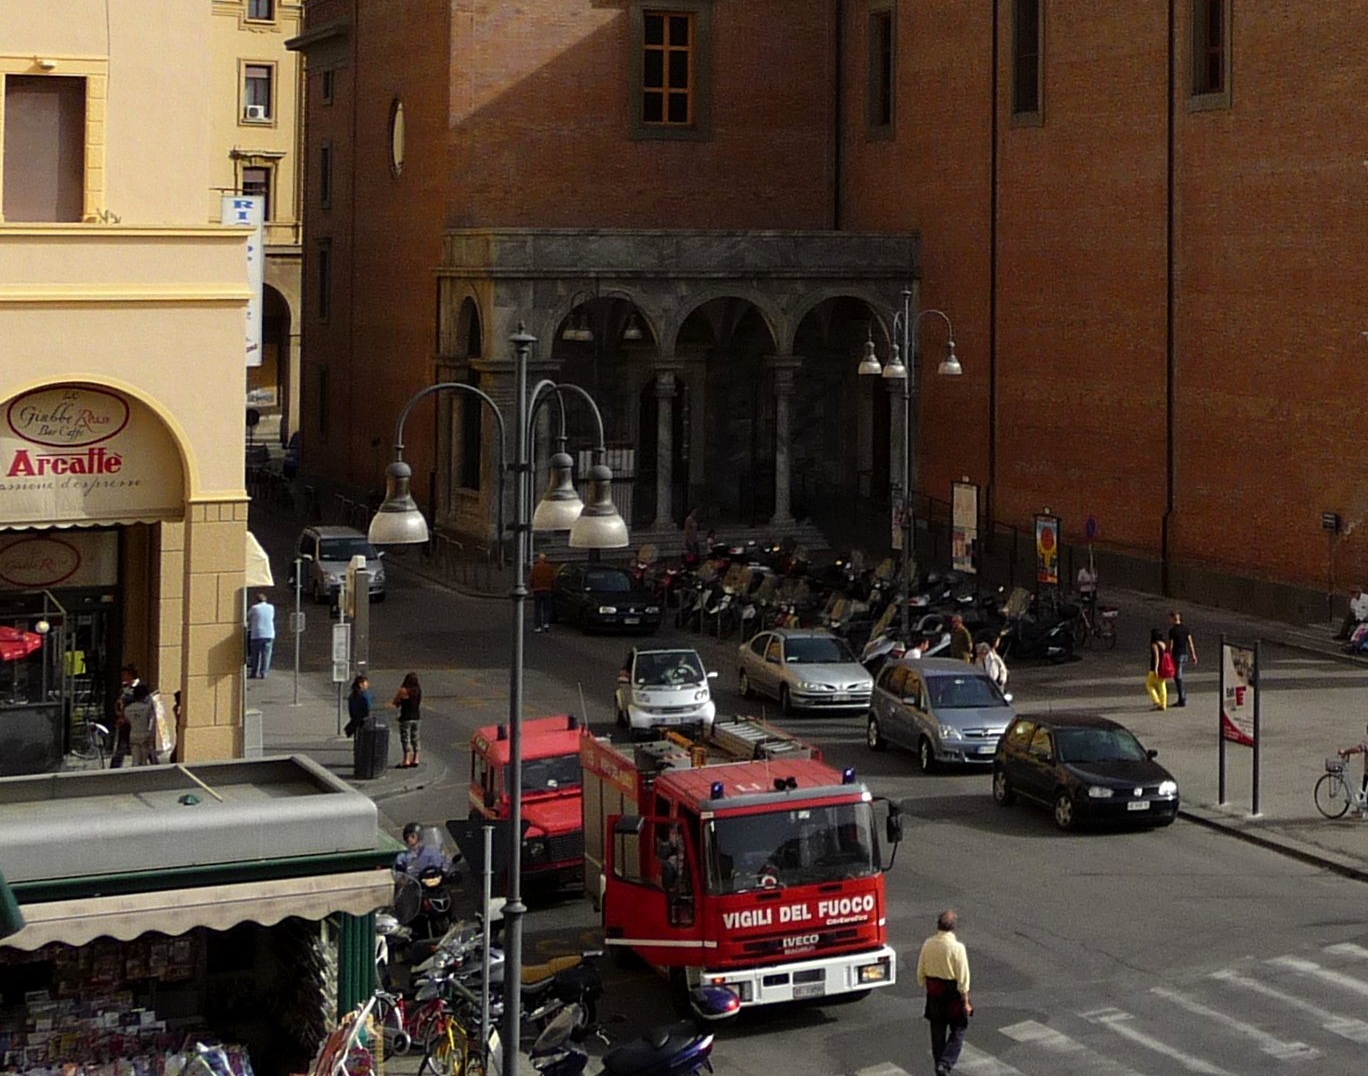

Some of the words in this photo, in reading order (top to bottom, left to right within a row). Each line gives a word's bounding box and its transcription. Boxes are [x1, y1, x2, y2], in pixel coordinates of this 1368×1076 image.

[6, 447, 122, 477] Arcaffè
[0, 481, 54, 491] assione
[723, 908, 772, 930] VIGILI
[780, 903, 812, 923] DEL
[818, 895, 874, 918] FUOCO
[782, 934, 820, 948] IVECO
